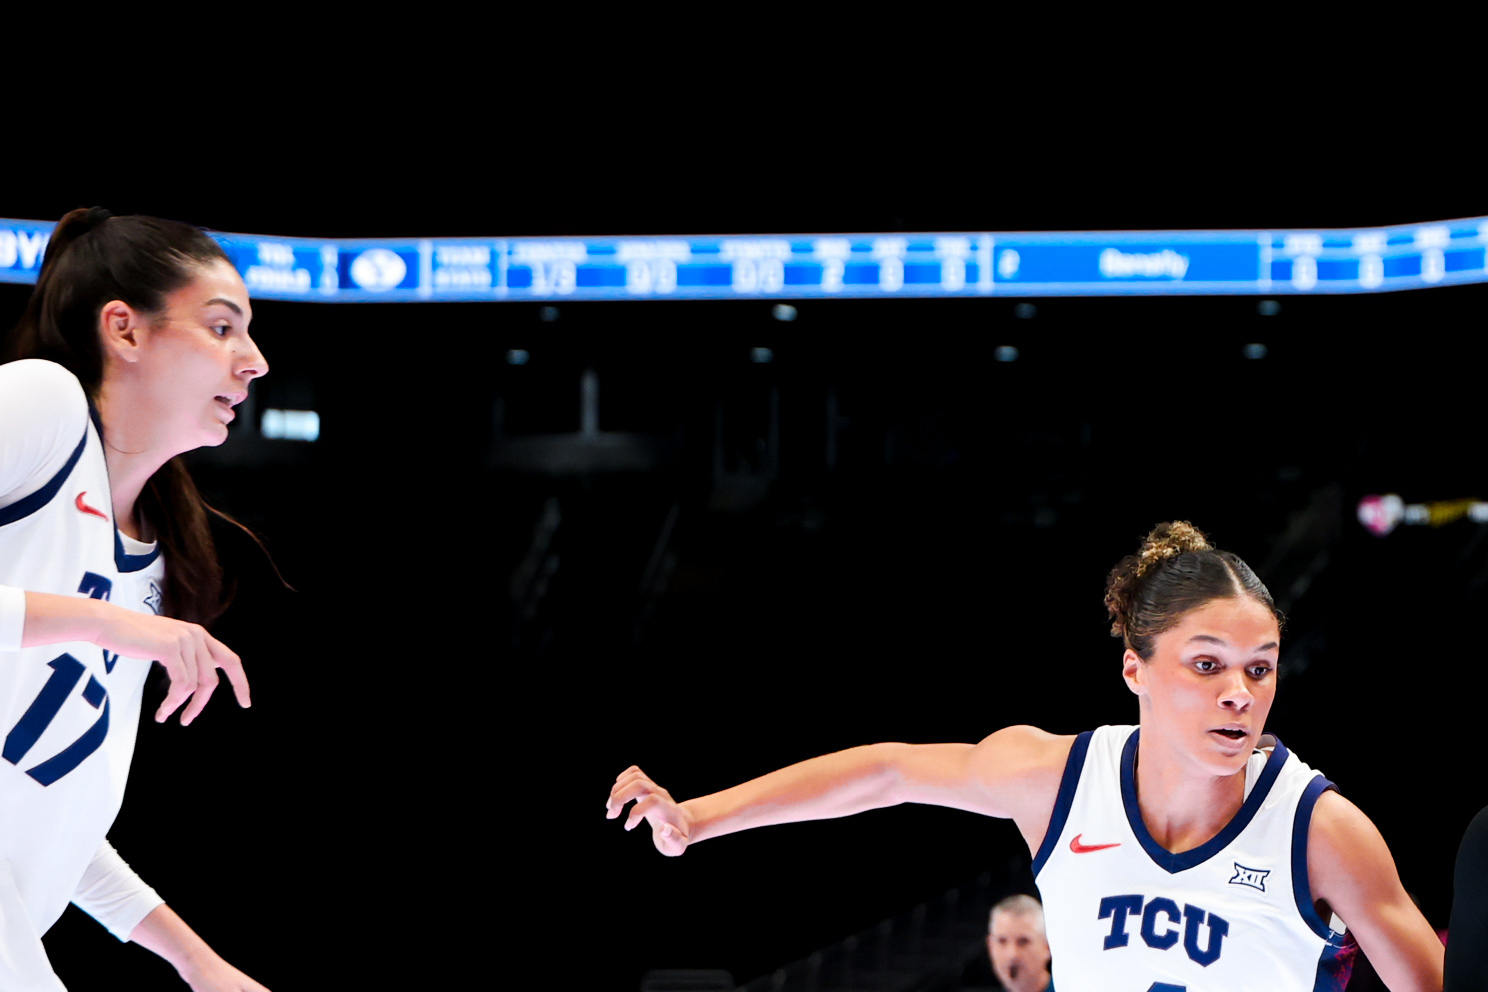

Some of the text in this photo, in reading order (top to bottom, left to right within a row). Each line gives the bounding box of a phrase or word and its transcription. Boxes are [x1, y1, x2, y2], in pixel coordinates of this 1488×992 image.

[0, 229, 44, 268] BY
[1, 652, 110, 788] 17
[1097, 893, 1230, 968] TCU
